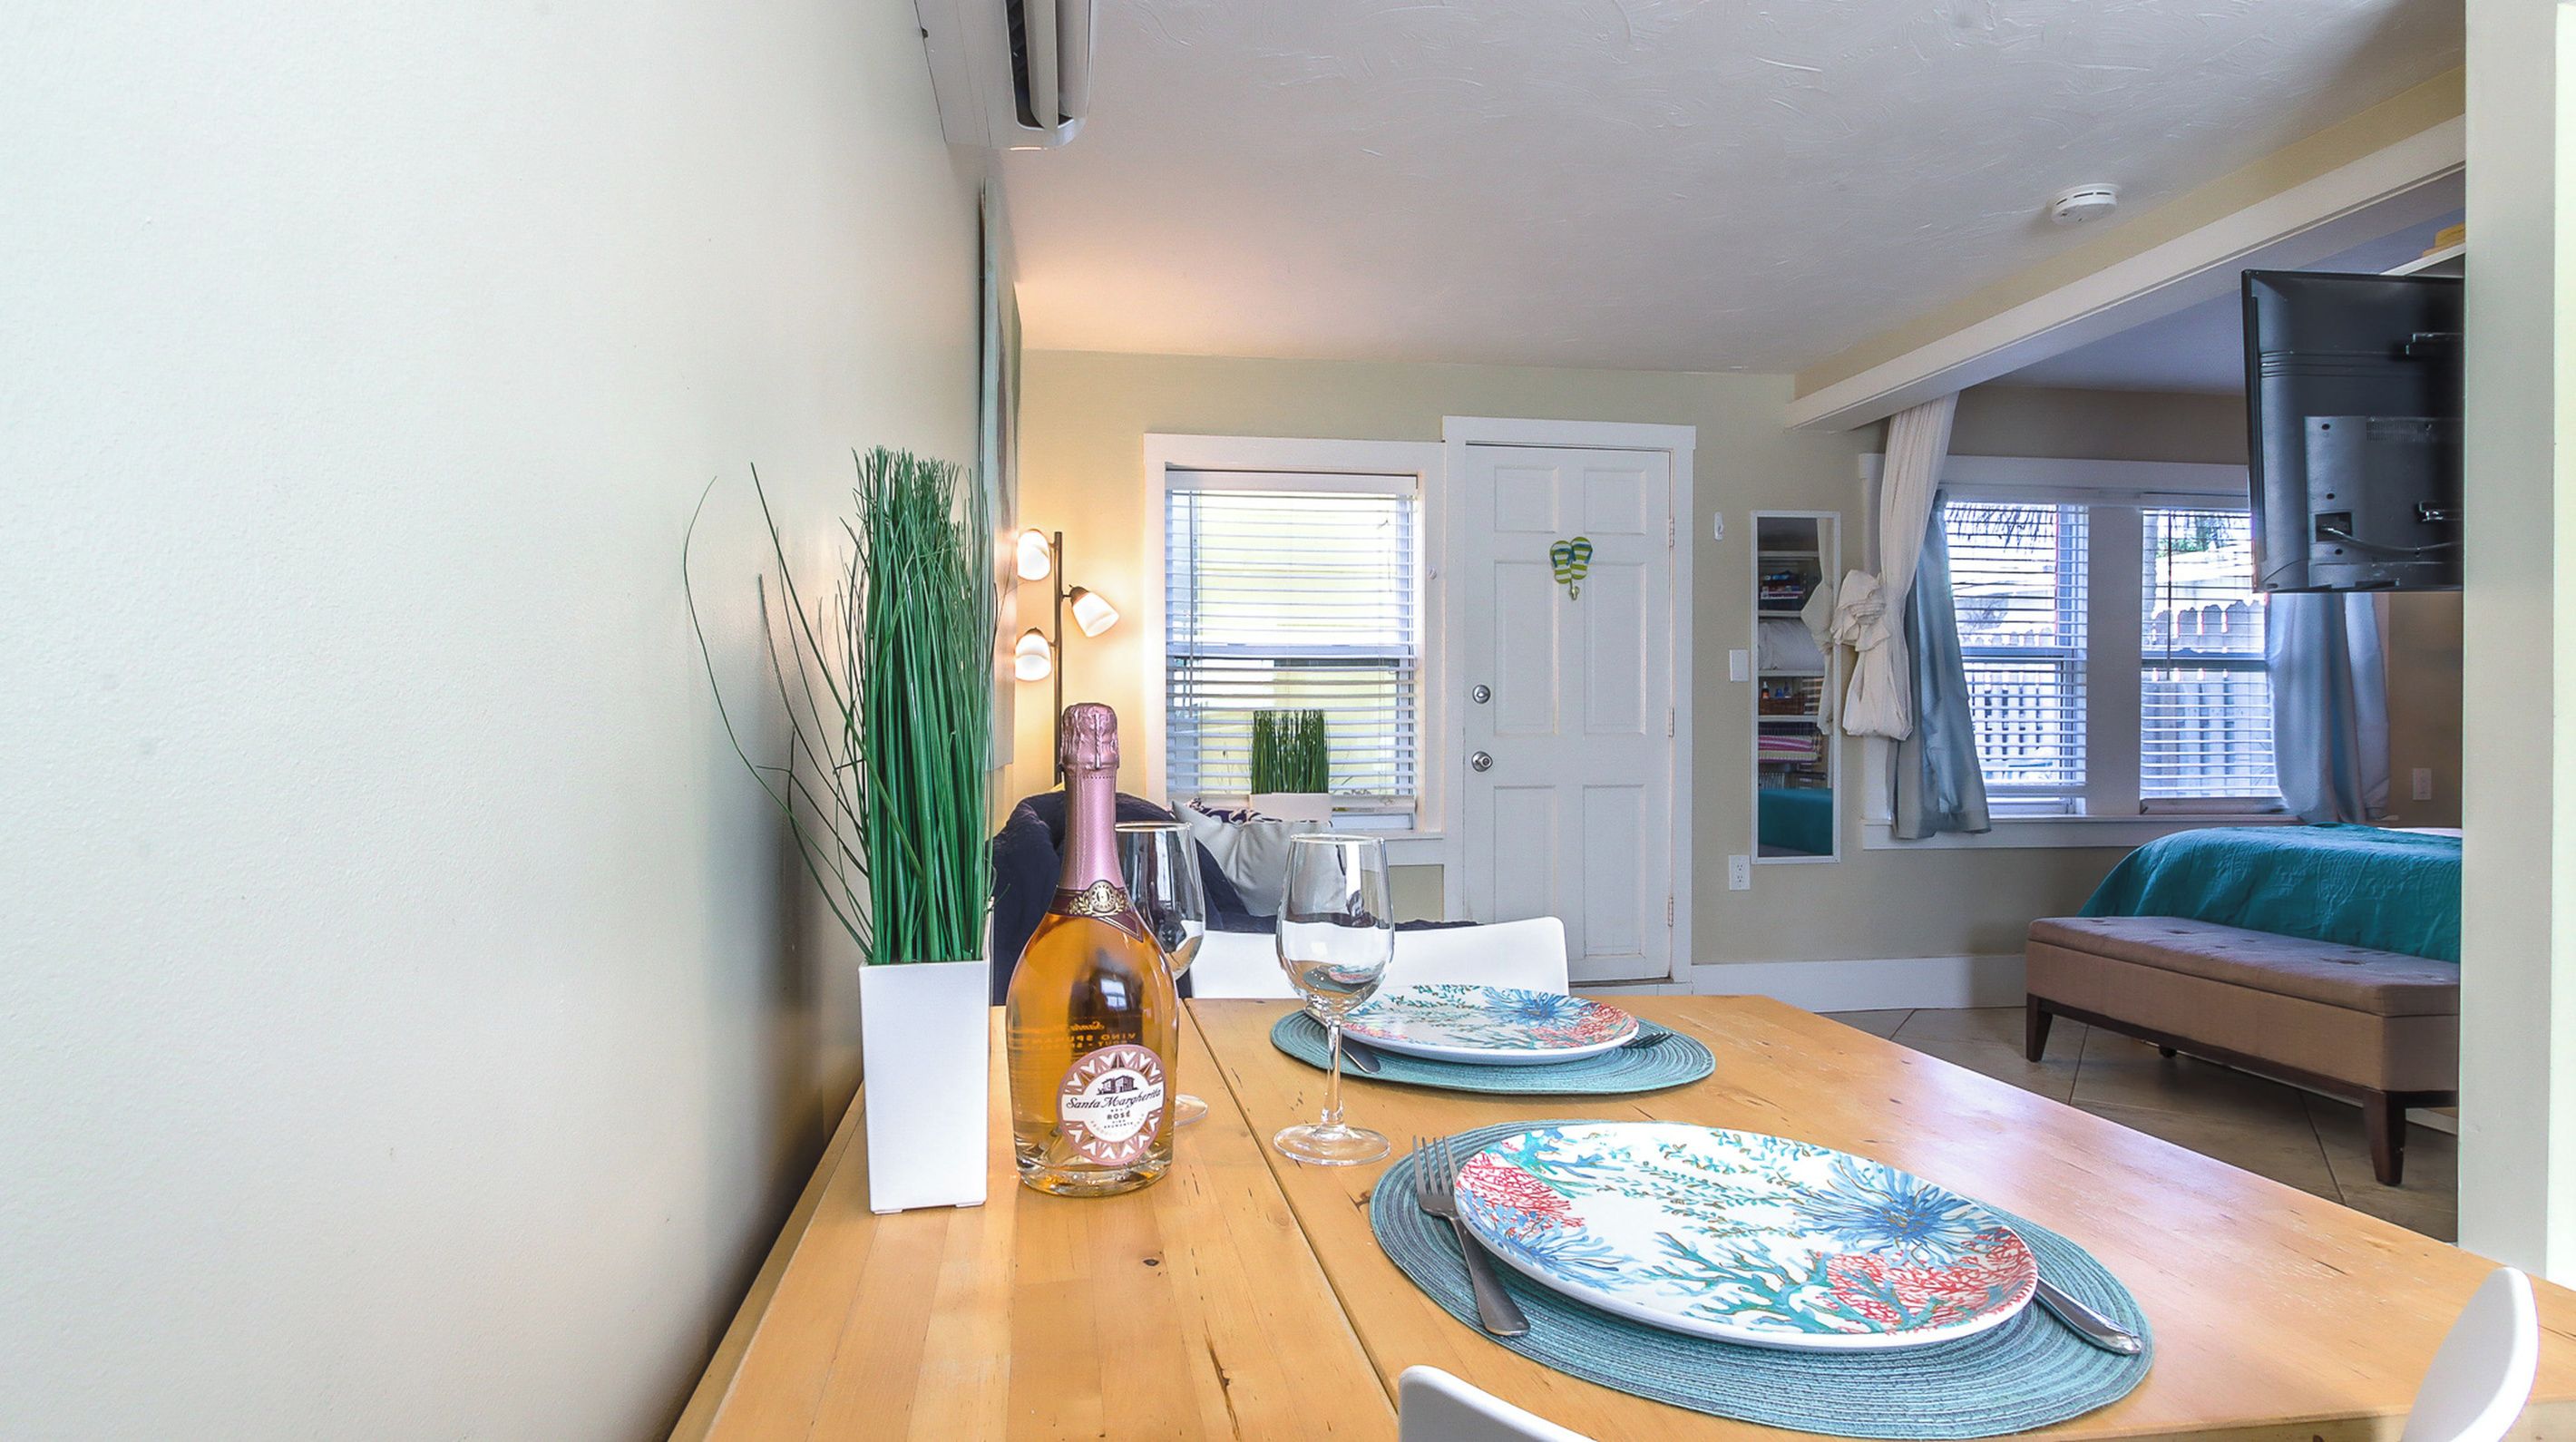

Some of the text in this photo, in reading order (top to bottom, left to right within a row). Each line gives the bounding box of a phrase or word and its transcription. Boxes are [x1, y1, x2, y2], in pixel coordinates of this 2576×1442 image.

[1066, 1087, 1161, 1110] Santa Margherita
[1107, 1110, 1130, 1120] ROSÉ
